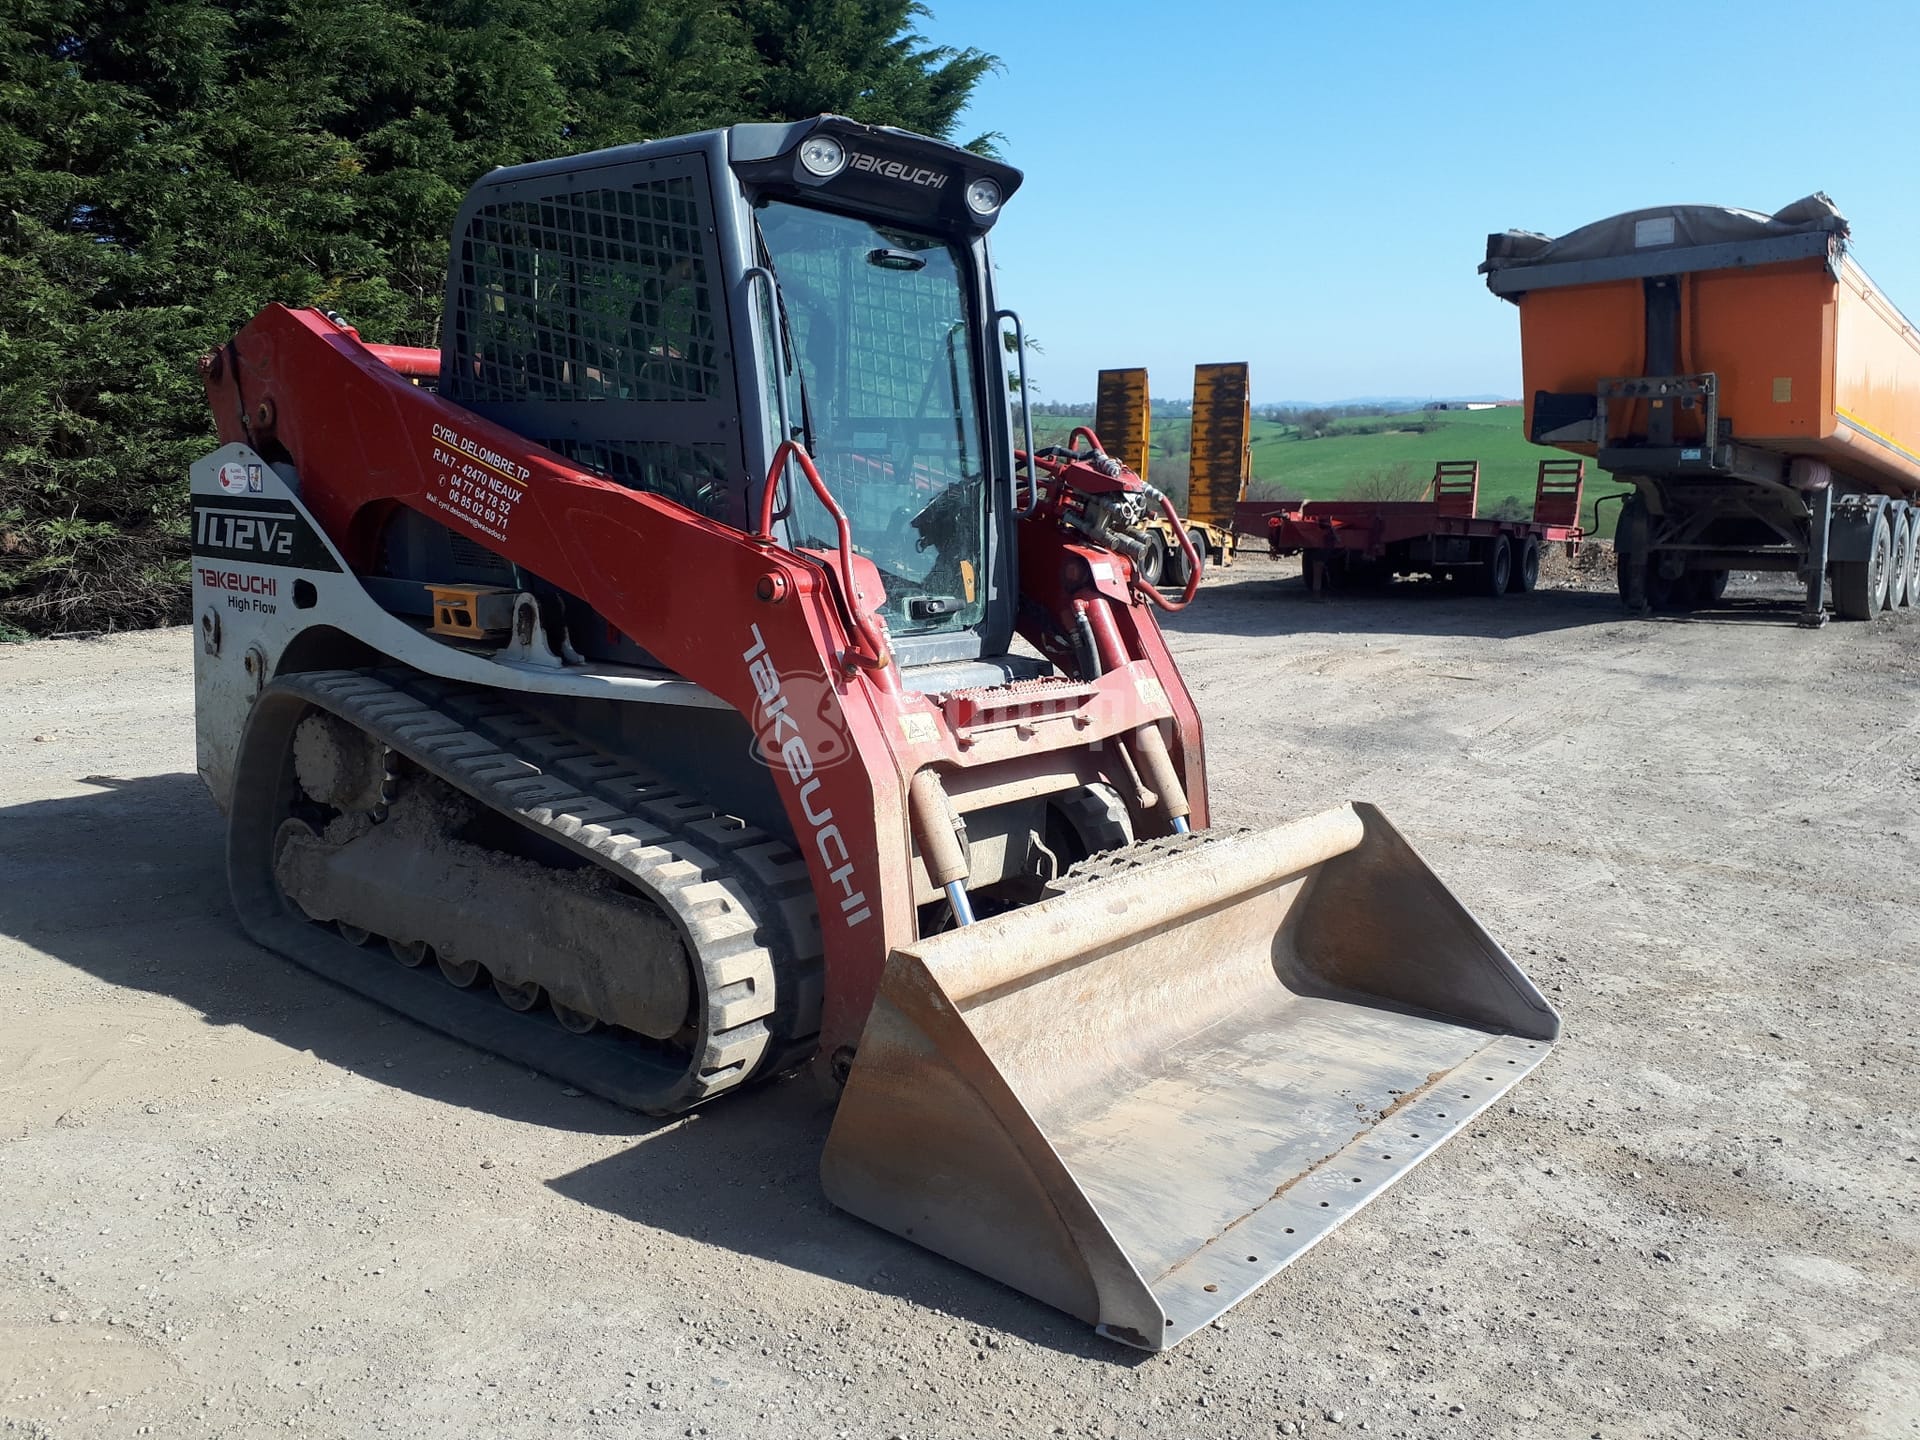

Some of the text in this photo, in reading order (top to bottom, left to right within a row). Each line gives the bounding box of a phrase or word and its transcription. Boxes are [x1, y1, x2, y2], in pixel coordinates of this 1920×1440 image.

[432, 423, 530, 481] CYRIL DELOMBRE.TP
[433, 448, 456, 469] R.N.7
[462, 464, 487, 485] 42470
[488, 477, 522, 504] NEAUX
[451, 474, 511, 515] 04 77 64 78 52
[449, 489, 508, 529] 06 85 02 69 71
[228, 596, 277, 615] High Flow
